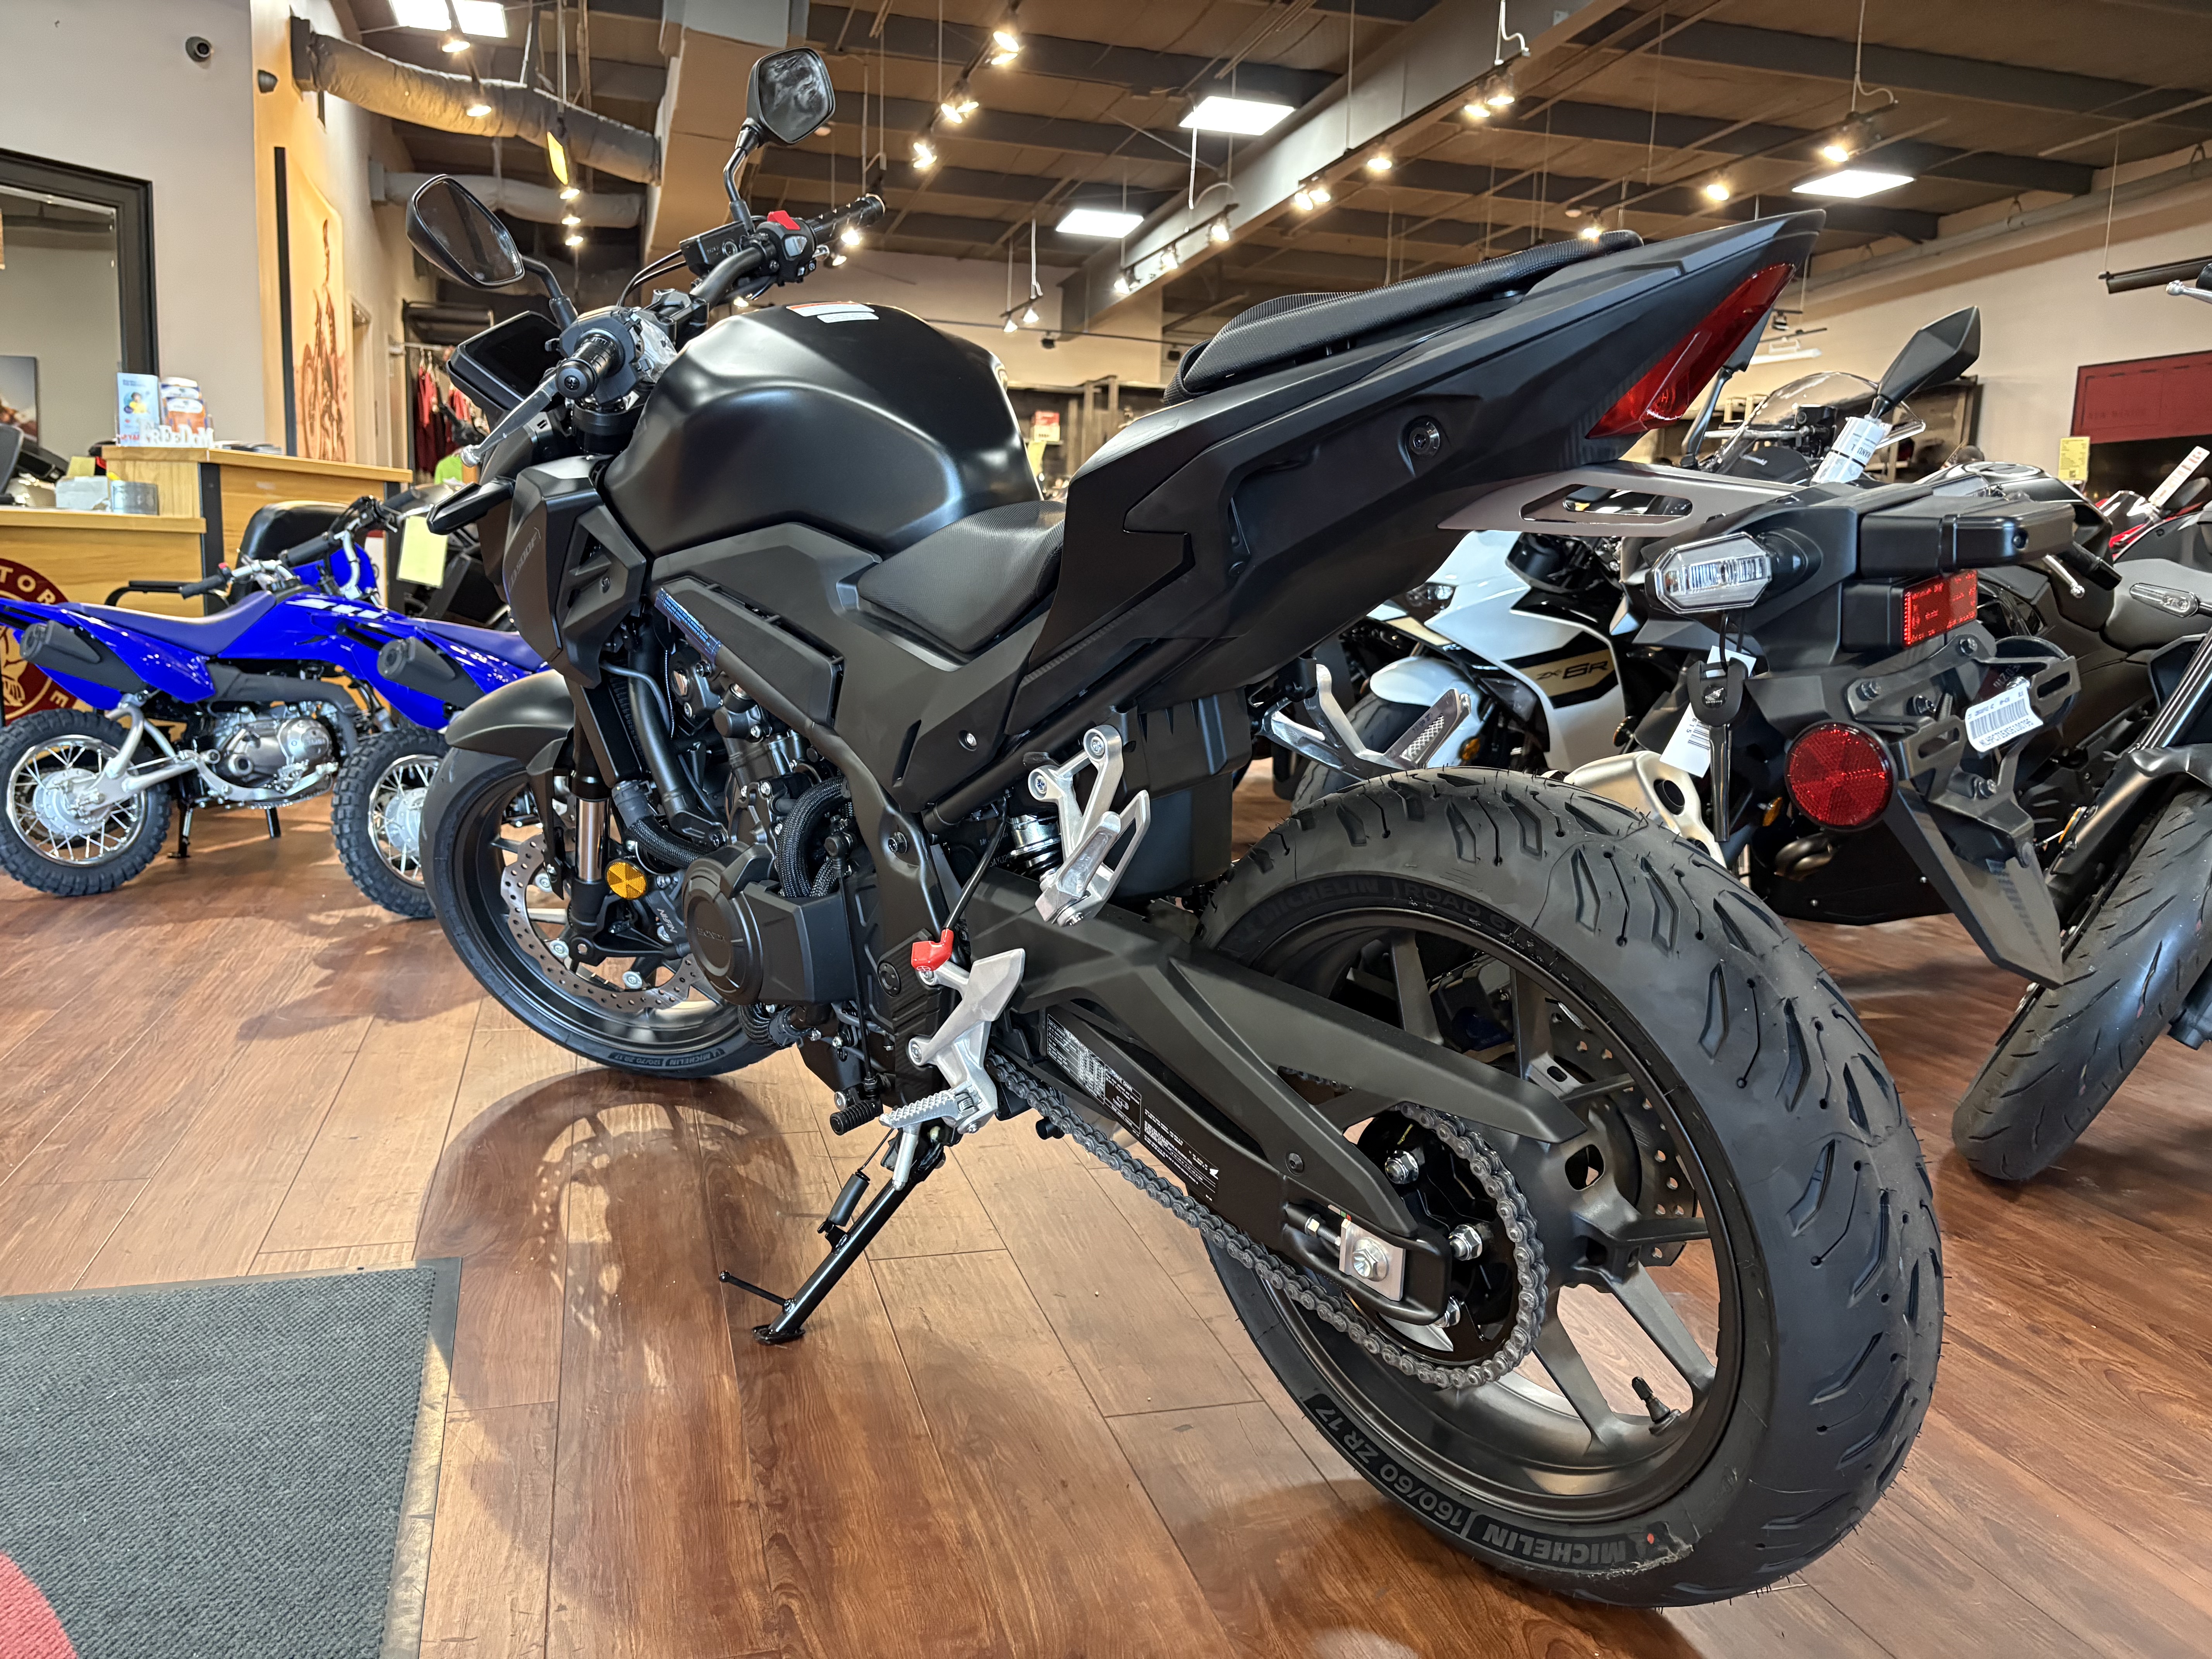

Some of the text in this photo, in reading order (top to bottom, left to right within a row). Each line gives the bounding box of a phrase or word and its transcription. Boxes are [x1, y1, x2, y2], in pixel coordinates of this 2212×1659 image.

[1405, 881, 1481, 917] ROAD
[1315, 1408, 1625, 1564] MICHELIN 160/60 ZR 17
